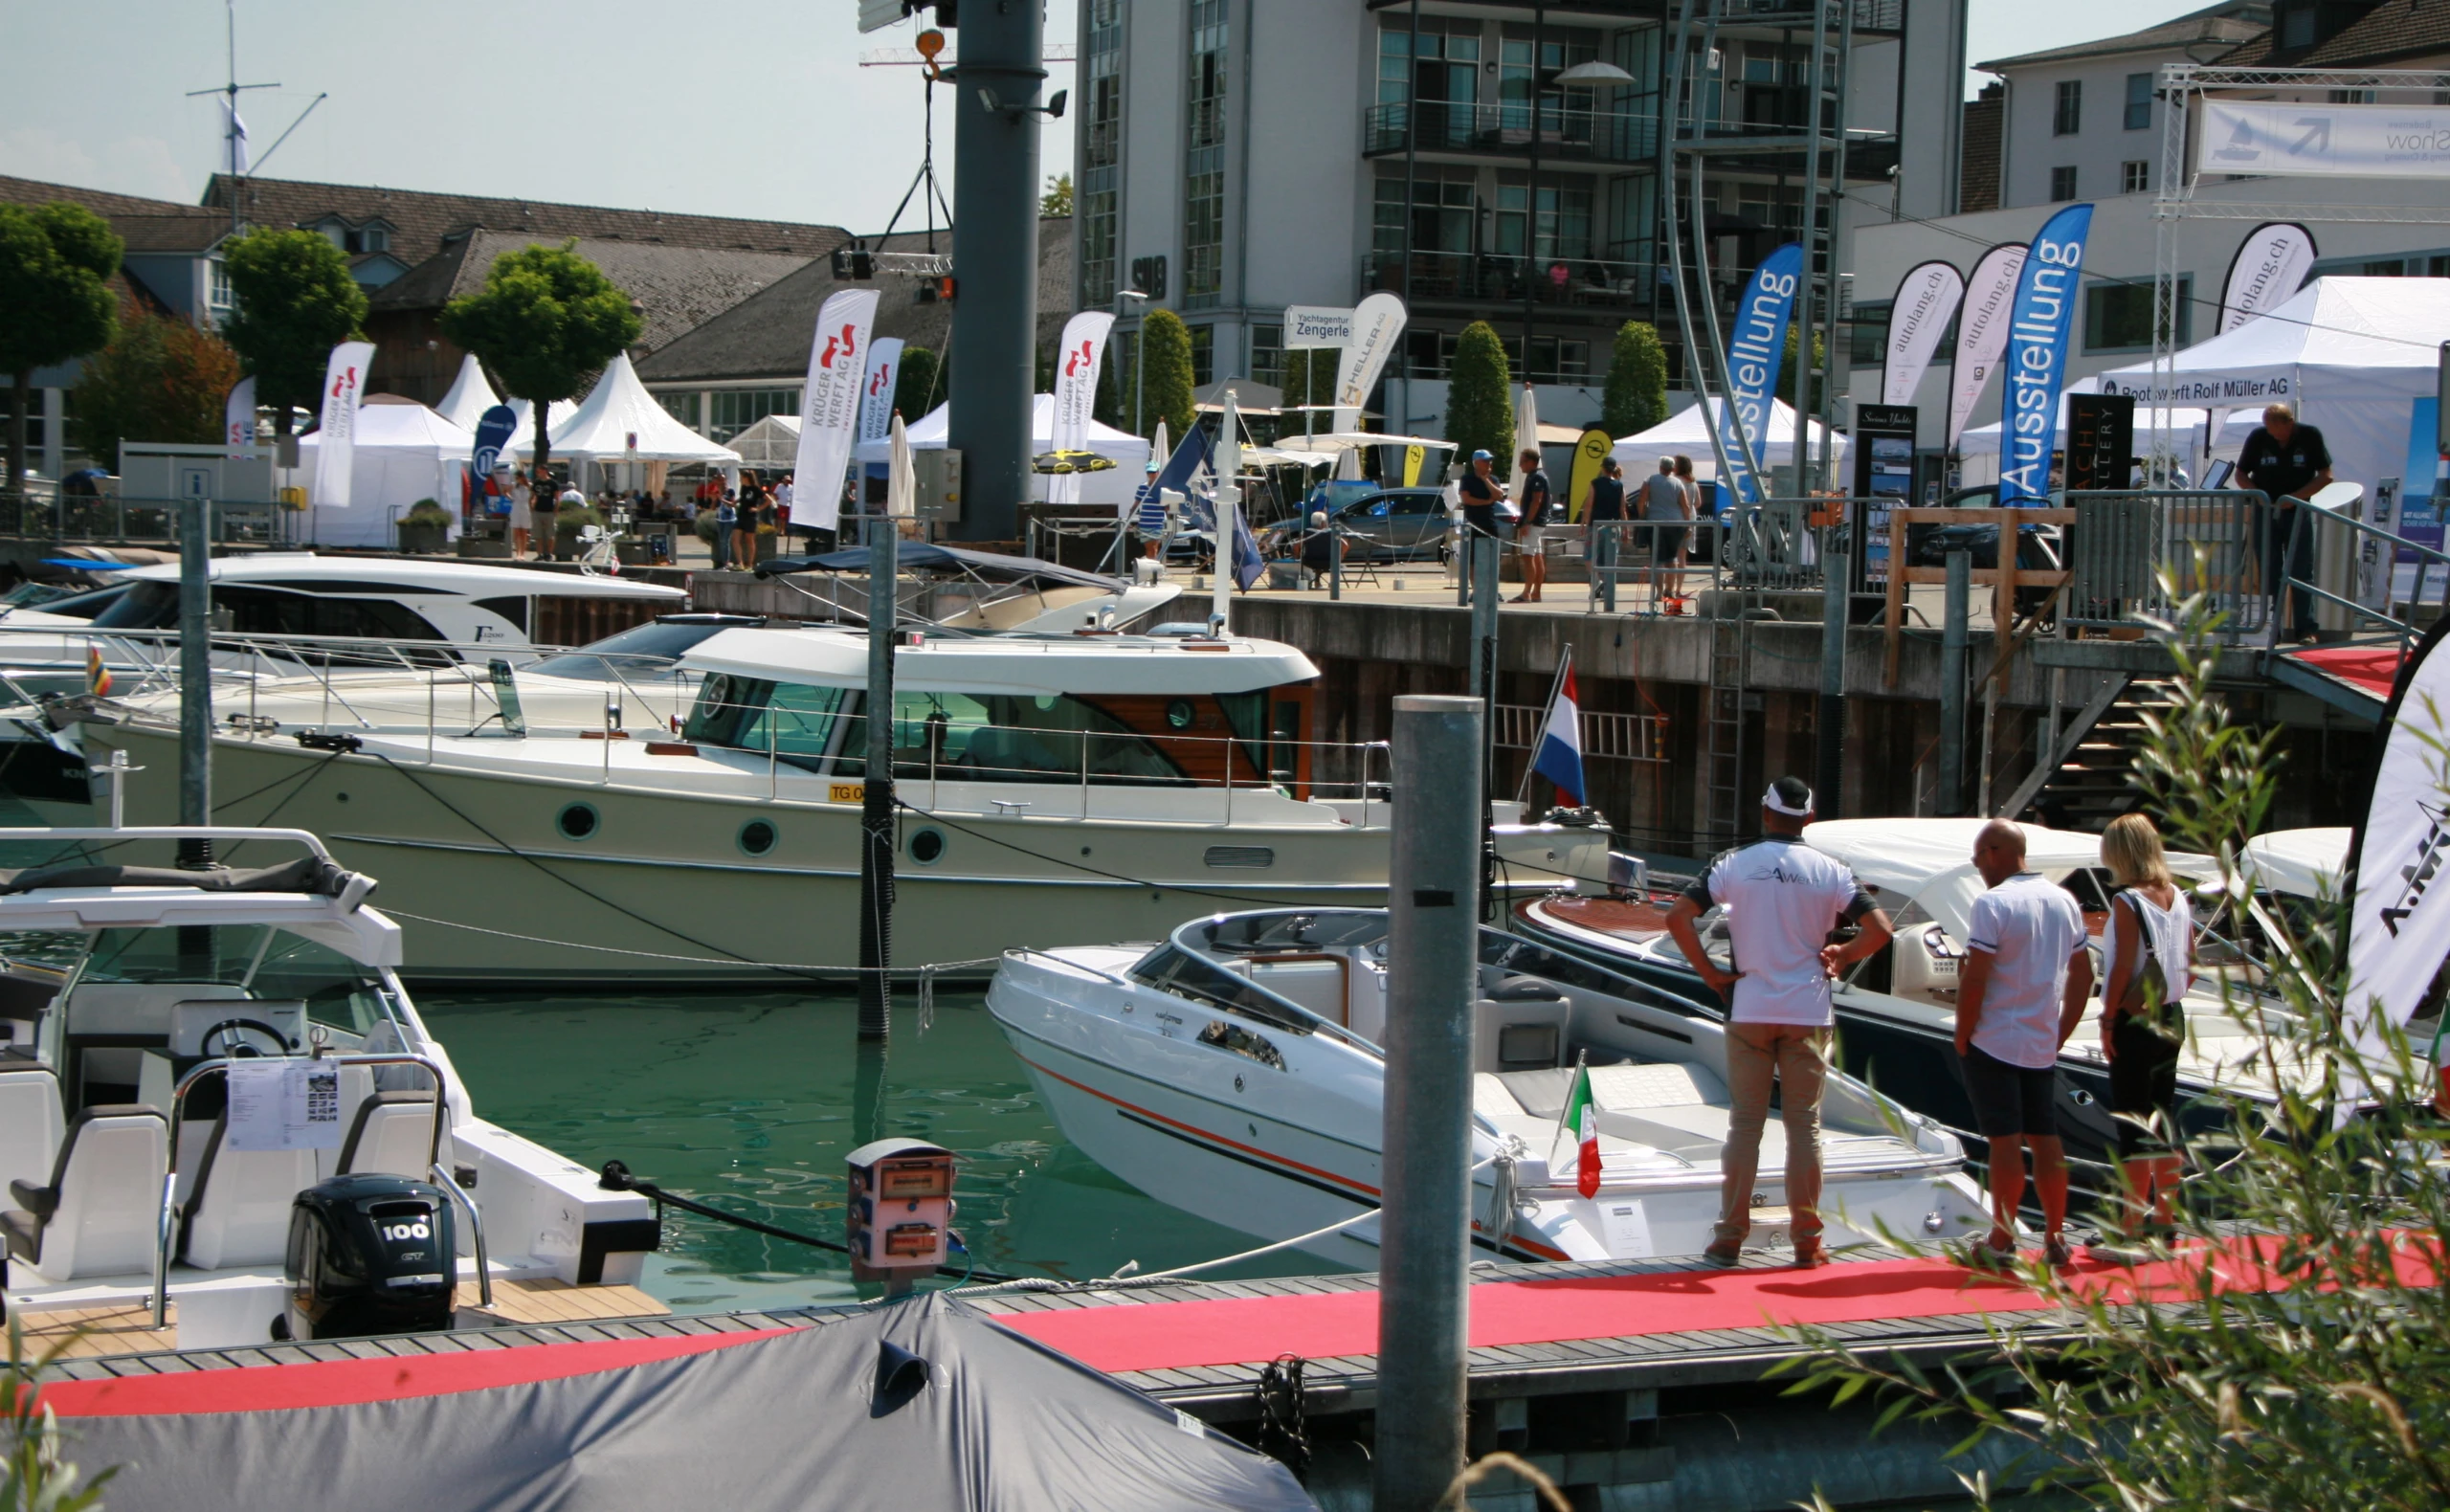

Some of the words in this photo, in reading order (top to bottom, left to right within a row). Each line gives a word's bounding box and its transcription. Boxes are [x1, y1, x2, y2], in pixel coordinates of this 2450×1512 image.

[1964, 256, 2021, 349] autolang.ch
[2228, 238, 2290, 331] utolang.ch
[1297, 322, 1349, 340] Zengerle
[1298, 313, 1350, 325] Yachtagentur
[1895, 270, 1944, 353] autolang.ch
[1348, 327, 1381, 385] HELLER
[1376, 312, 1387, 327] AG
[2001, 238, 2081, 495] Ausstellung
[812, 371, 832, 427] KRÜGER
[827, 384, 847, 429] WERFT
[837, 360, 850, 383] AG
[1078, 369, 1089, 387] AG
[2122, 386, 2191, 402] Bootwrft
[2194, 382, 2219, 399] Rolf
[2223, 380, 2265, 398] Müller
[2268, 377, 2288, 395] AG
[866, 398, 878, 439] KRÜGER
[1060, 381, 1075, 427] KRÜGER
[1072, 389, 1086, 427] WERFT
[2074, 407, 2095, 490] ACHT
[2098, 408, 2113, 490] LLERY
[832, 786, 851, 799] TG
[383, 1223, 430, 1241] 100
